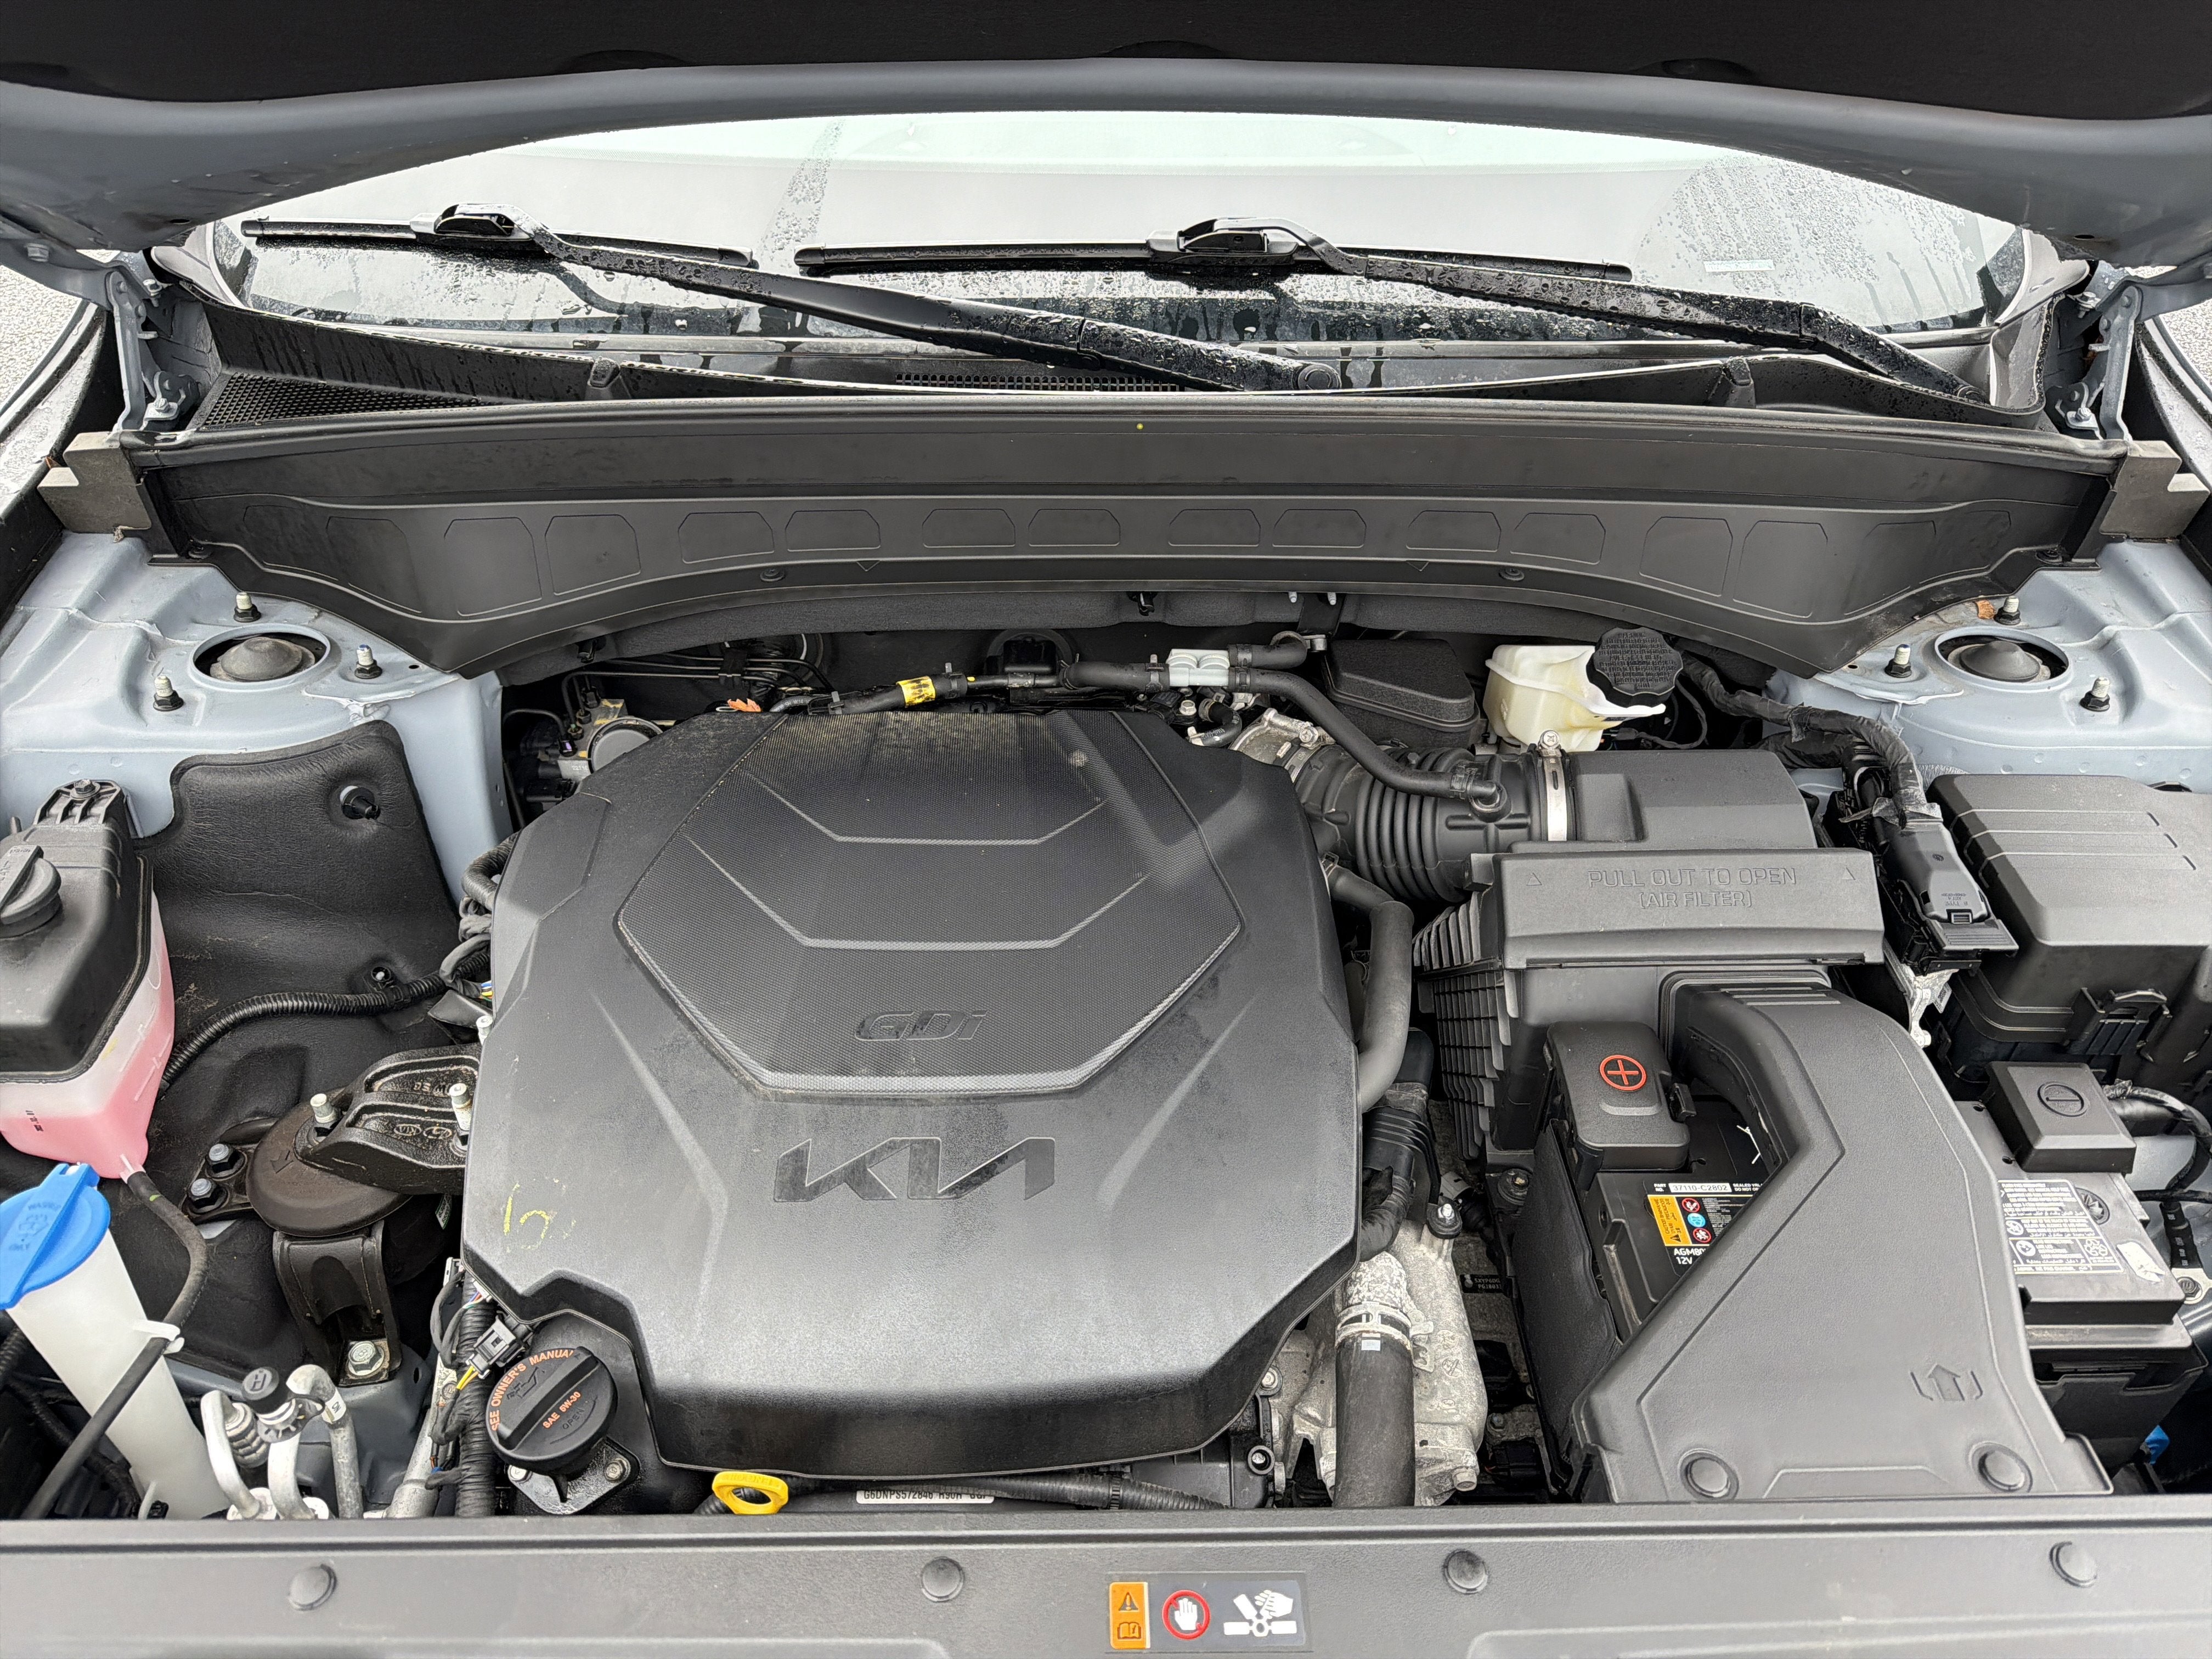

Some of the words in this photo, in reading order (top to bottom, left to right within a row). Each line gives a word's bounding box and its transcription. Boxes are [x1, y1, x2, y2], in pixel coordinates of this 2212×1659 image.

[1587, 870, 1645, 888] PULL
[1651, 868, 1696, 887] OUT
[1701, 868, 1731, 885] TO
[1738, 867, 1797, 885] OPEN
[1639, 891, 1678, 910] (AIR
[1683, 890, 1752, 908] FILTER)
[1674, 1248, 1706, 1256] AGM80
[1676, 1256, 1692, 1265] 12V
[491, 1363, 527, 1407] OWNER'S
[489, 1409, 500, 1431] SEE
[543, 1412, 561, 1429] SAE
[562, 1407, 585, 1430] OPEN
